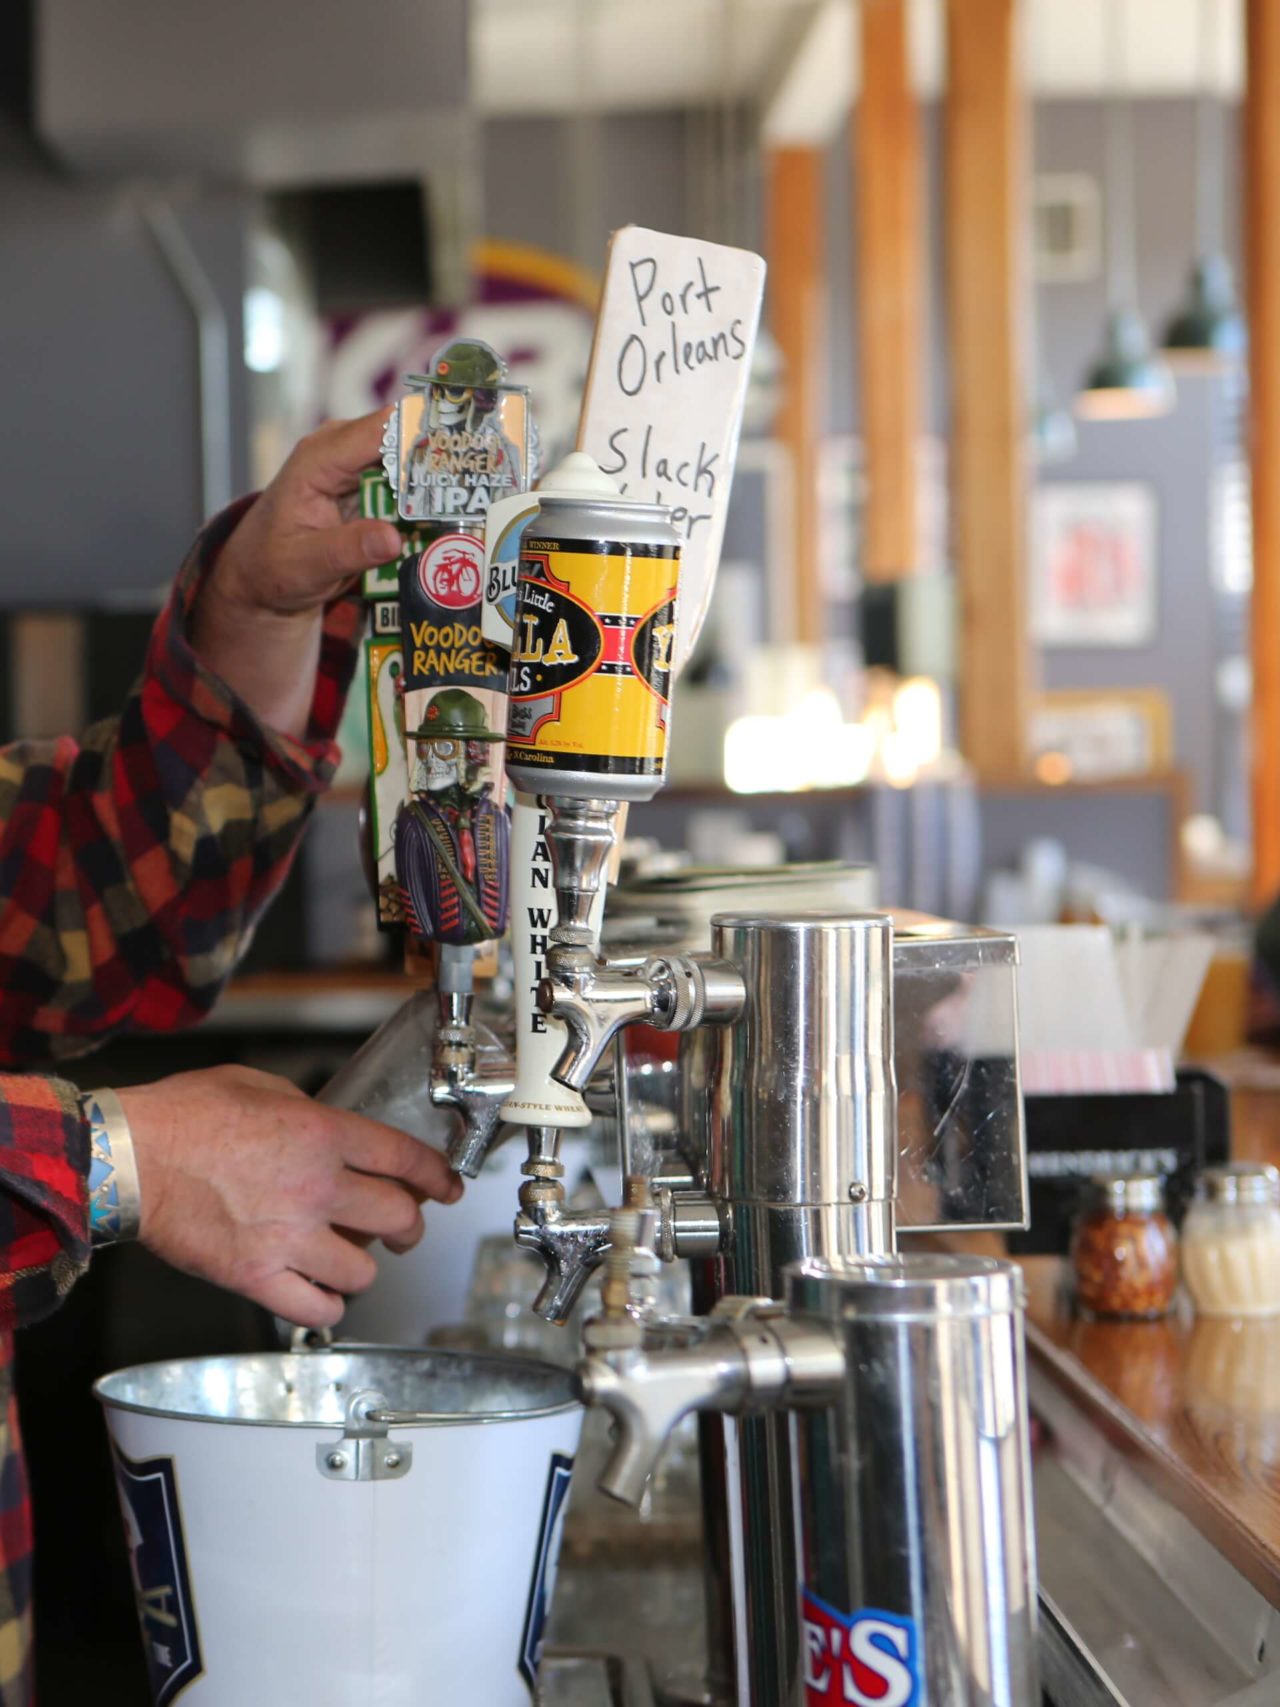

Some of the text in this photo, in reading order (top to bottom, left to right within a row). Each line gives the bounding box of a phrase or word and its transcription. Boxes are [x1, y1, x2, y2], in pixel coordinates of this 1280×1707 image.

[629, 256, 721, 326] Port
[617, 318, 746, 397] Orleans
[427, 429, 500, 452] VOODOO
[431, 449, 498, 474] RANGER
[598, 424, 720, 499] Slack
[408, 474, 513, 488] JUICY HAZE
[434, 487, 491, 515] IPA
[528, 540, 561, 551] WINNER
[523, 582, 556, 613] Little
[412, 648, 498, 677] RANGER
